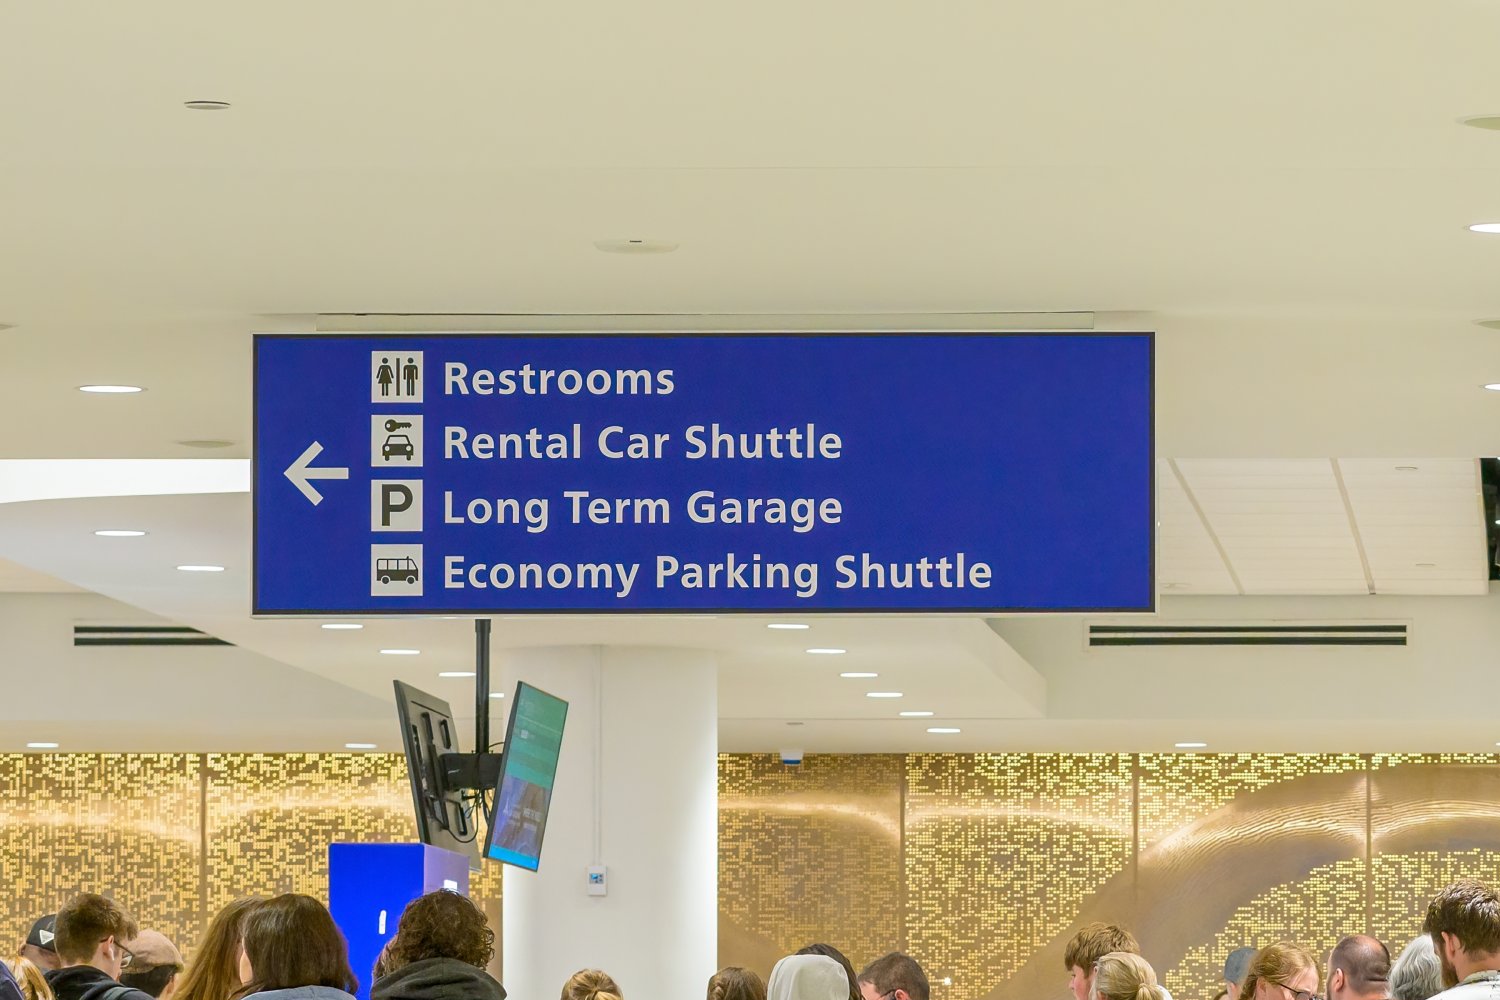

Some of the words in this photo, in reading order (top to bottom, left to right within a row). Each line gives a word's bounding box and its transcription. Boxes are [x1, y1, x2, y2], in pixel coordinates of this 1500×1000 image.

[445, 363, 674, 394] Restrooms
[445, 424, 580, 459] Rental
[599, 426, 669, 458] Car
[686, 424, 841, 458] Shuttle
[382, 485, 413, 526] P
[445, 491, 548, 533] Long
[564, 491, 669, 523] Term
[687, 491, 842, 532] Garage
[445, 556, 639, 597] Economy
[657, 553, 817, 597] Parking
[836, 553, 991, 588] Shuttle
